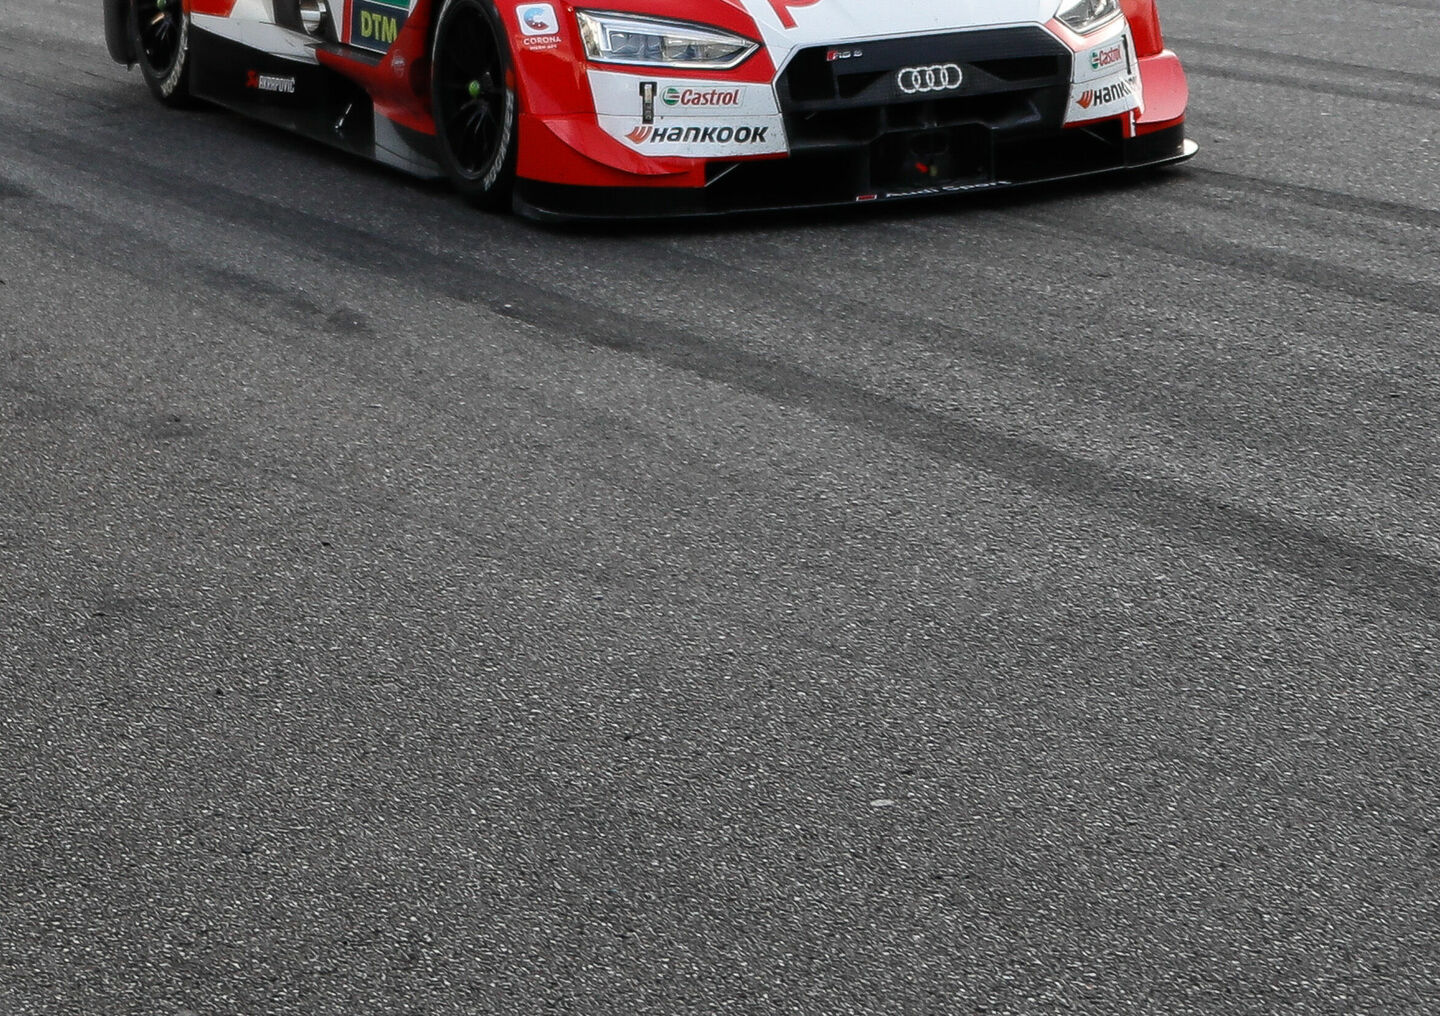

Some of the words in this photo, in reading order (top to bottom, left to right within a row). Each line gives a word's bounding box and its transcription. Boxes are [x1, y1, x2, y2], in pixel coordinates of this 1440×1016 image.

[361, 10, 398, 44] DTM
[523, 35, 562, 46] CORONA
[680, 87, 740, 106] Castrol
